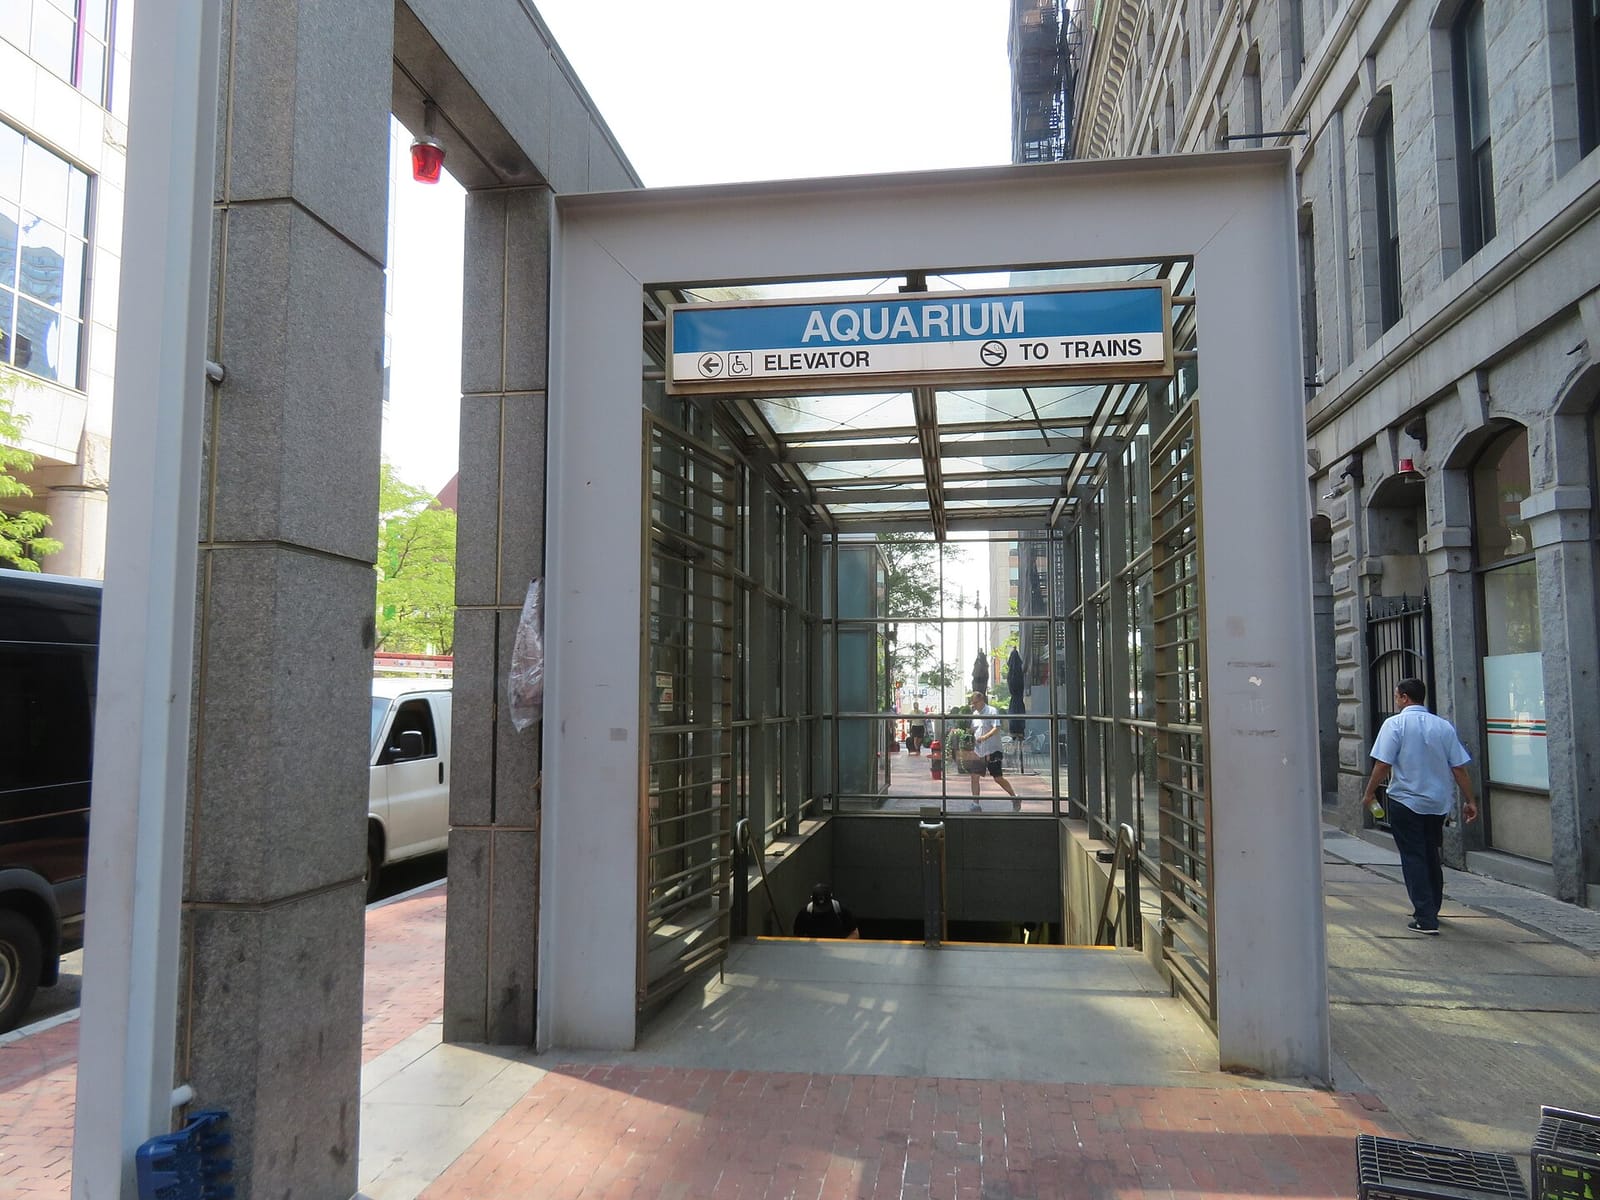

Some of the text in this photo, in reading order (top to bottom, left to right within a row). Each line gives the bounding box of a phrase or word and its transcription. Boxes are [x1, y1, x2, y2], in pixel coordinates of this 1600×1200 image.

[801, 301, 1025, 343] AQUARIUM
[764, 351, 870, 371] ELEVATOR
[1019, 338, 1143, 361] TO TRAINS
